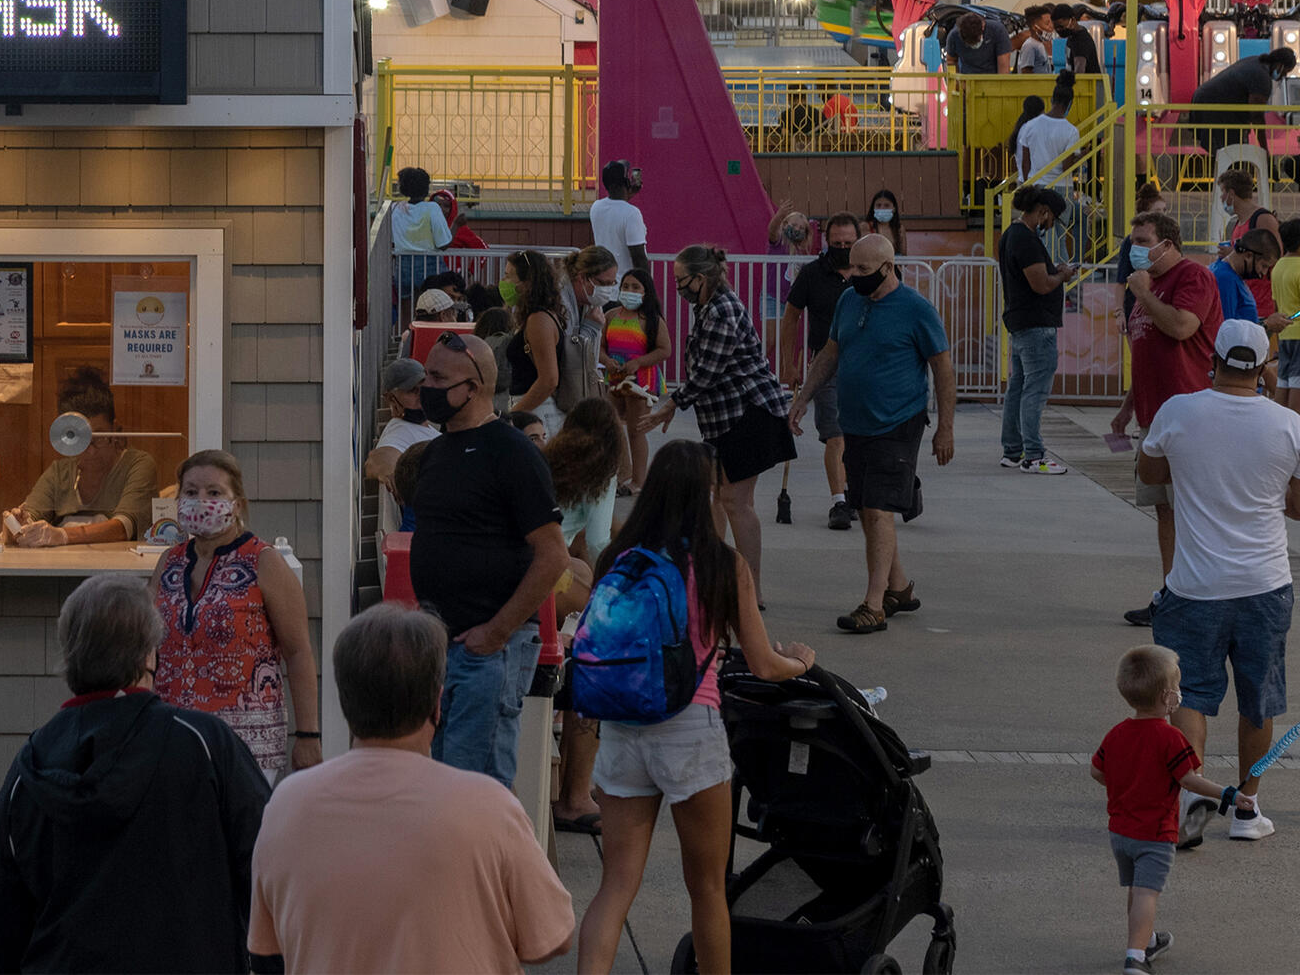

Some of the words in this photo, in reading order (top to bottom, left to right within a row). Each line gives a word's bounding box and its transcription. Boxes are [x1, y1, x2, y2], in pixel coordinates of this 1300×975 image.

[1141, 88, 1152, 99] 14
[124, 330, 156, 339] MASKS
[159, 330, 177, 339] ARE
[127, 343, 173, 353] REQUIRED
